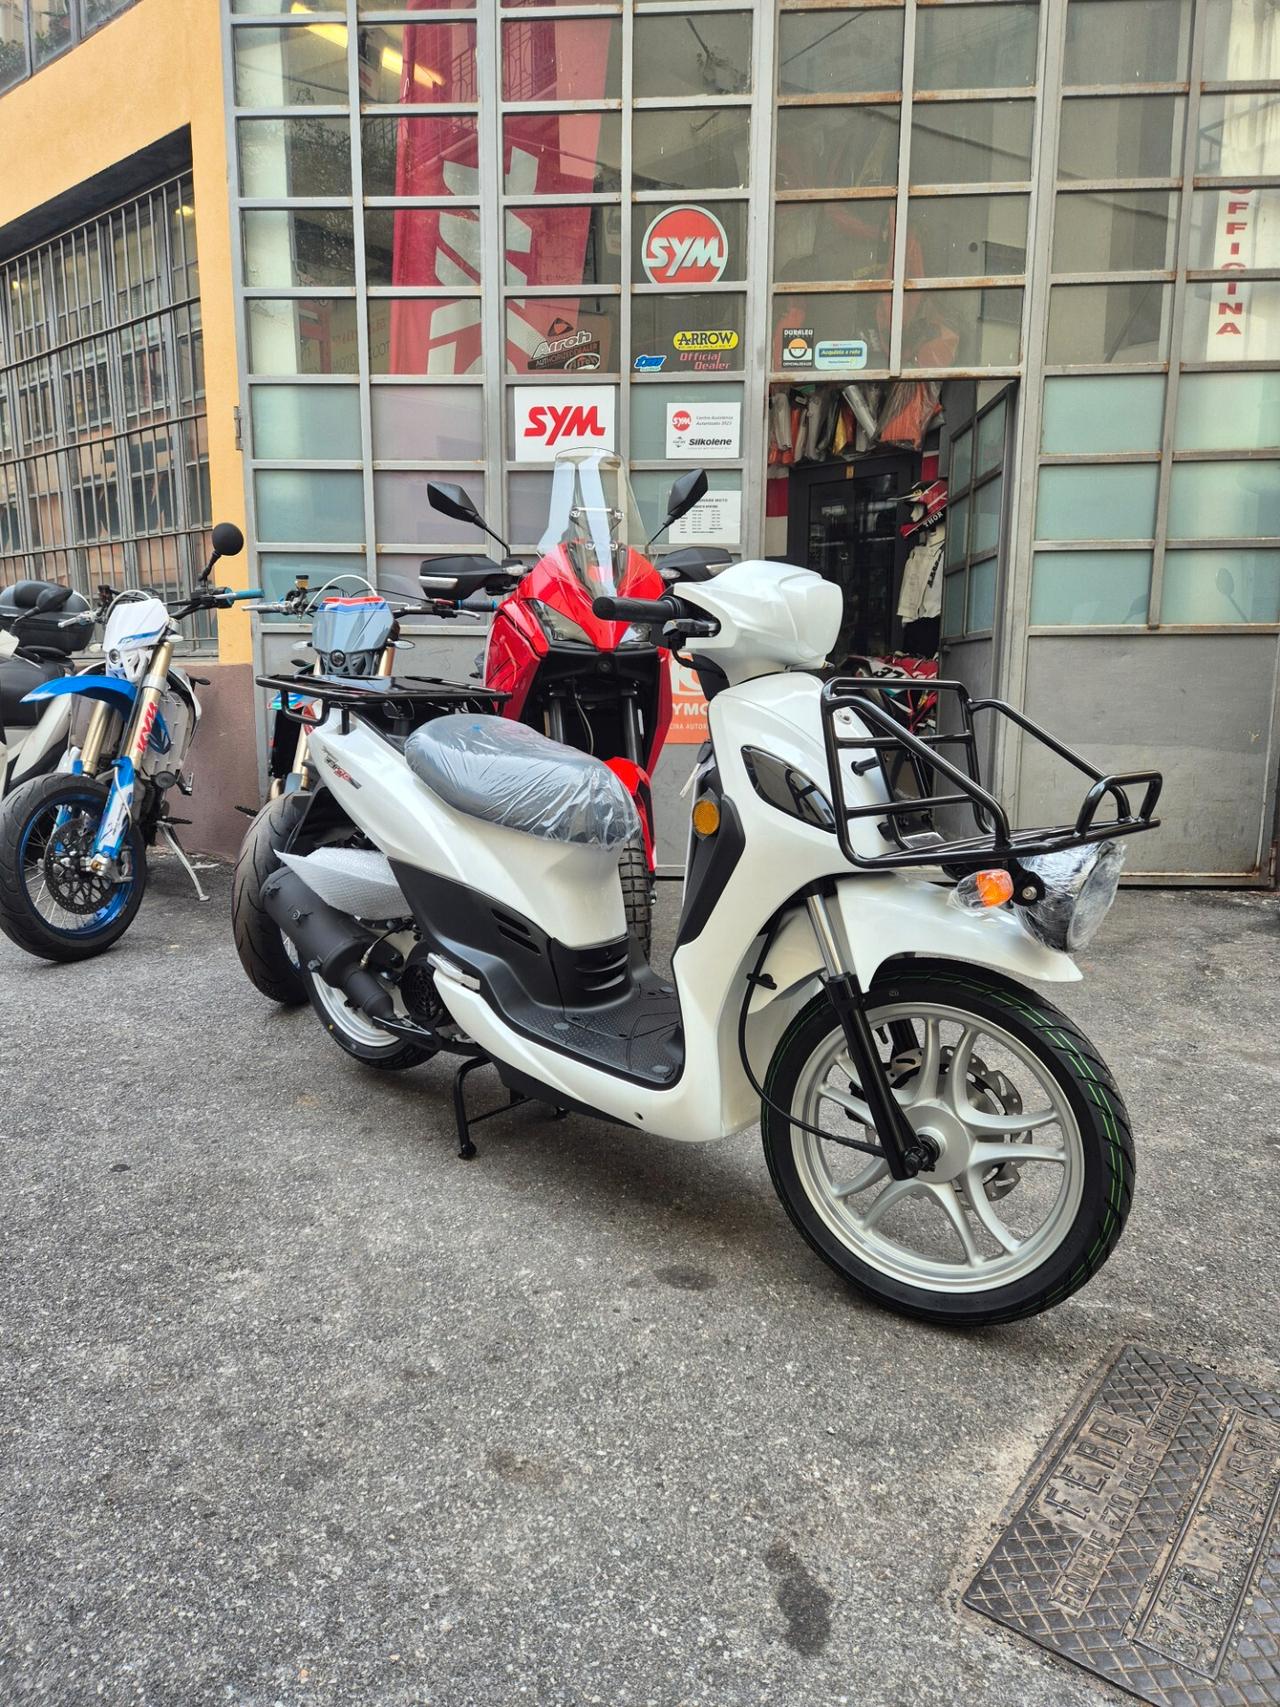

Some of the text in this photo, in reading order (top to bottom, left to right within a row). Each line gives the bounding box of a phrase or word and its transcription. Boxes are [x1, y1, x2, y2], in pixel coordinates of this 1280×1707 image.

[644, 236, 724, 277] SYM
[1215, 188, 1253, 336] FFIINA
[677, 332, 733, 346] ARROW
[680, 352, 721, 361] Official
[694, 360, 730, 370] Dealer
[524, 406, 606, 445] SYM
[672, 416, 691, 428] SYM
[688, 438, 732, 446] Silkolene
[924, 511, 944, 527] THOR
